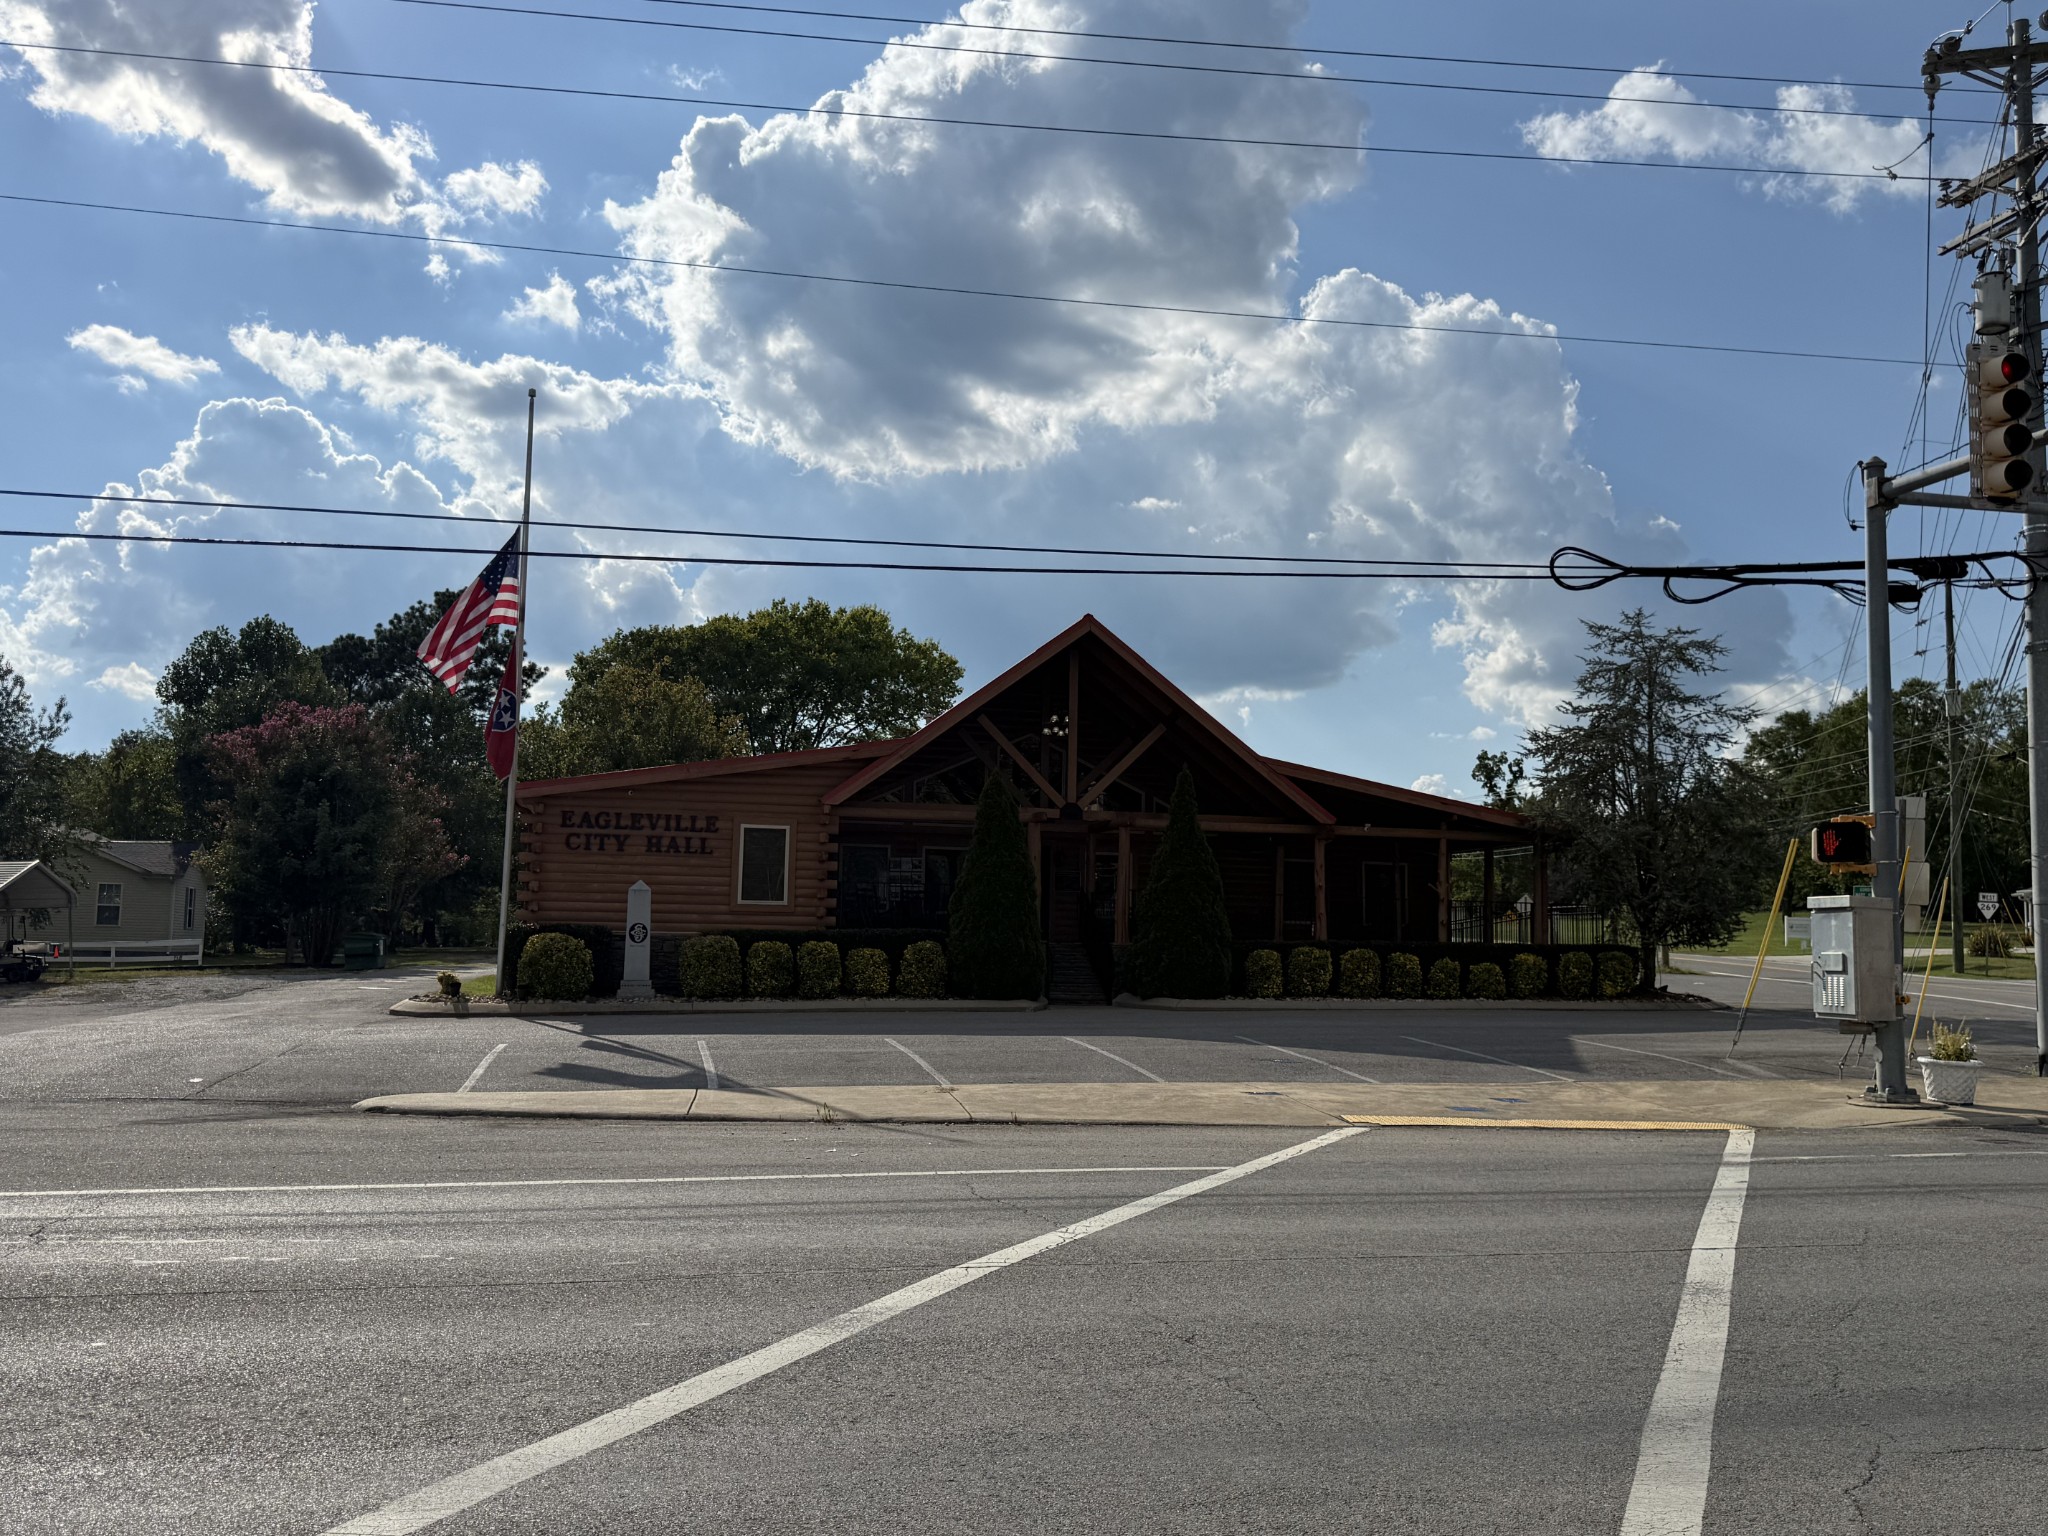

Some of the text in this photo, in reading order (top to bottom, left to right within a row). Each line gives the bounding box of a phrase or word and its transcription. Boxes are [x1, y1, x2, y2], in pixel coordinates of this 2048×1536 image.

[560, 810, 719, 833] EAGLEVILLE
[565, 833, 713, 854] CITY HALL
[1981, 903, 1997, 911] 269
